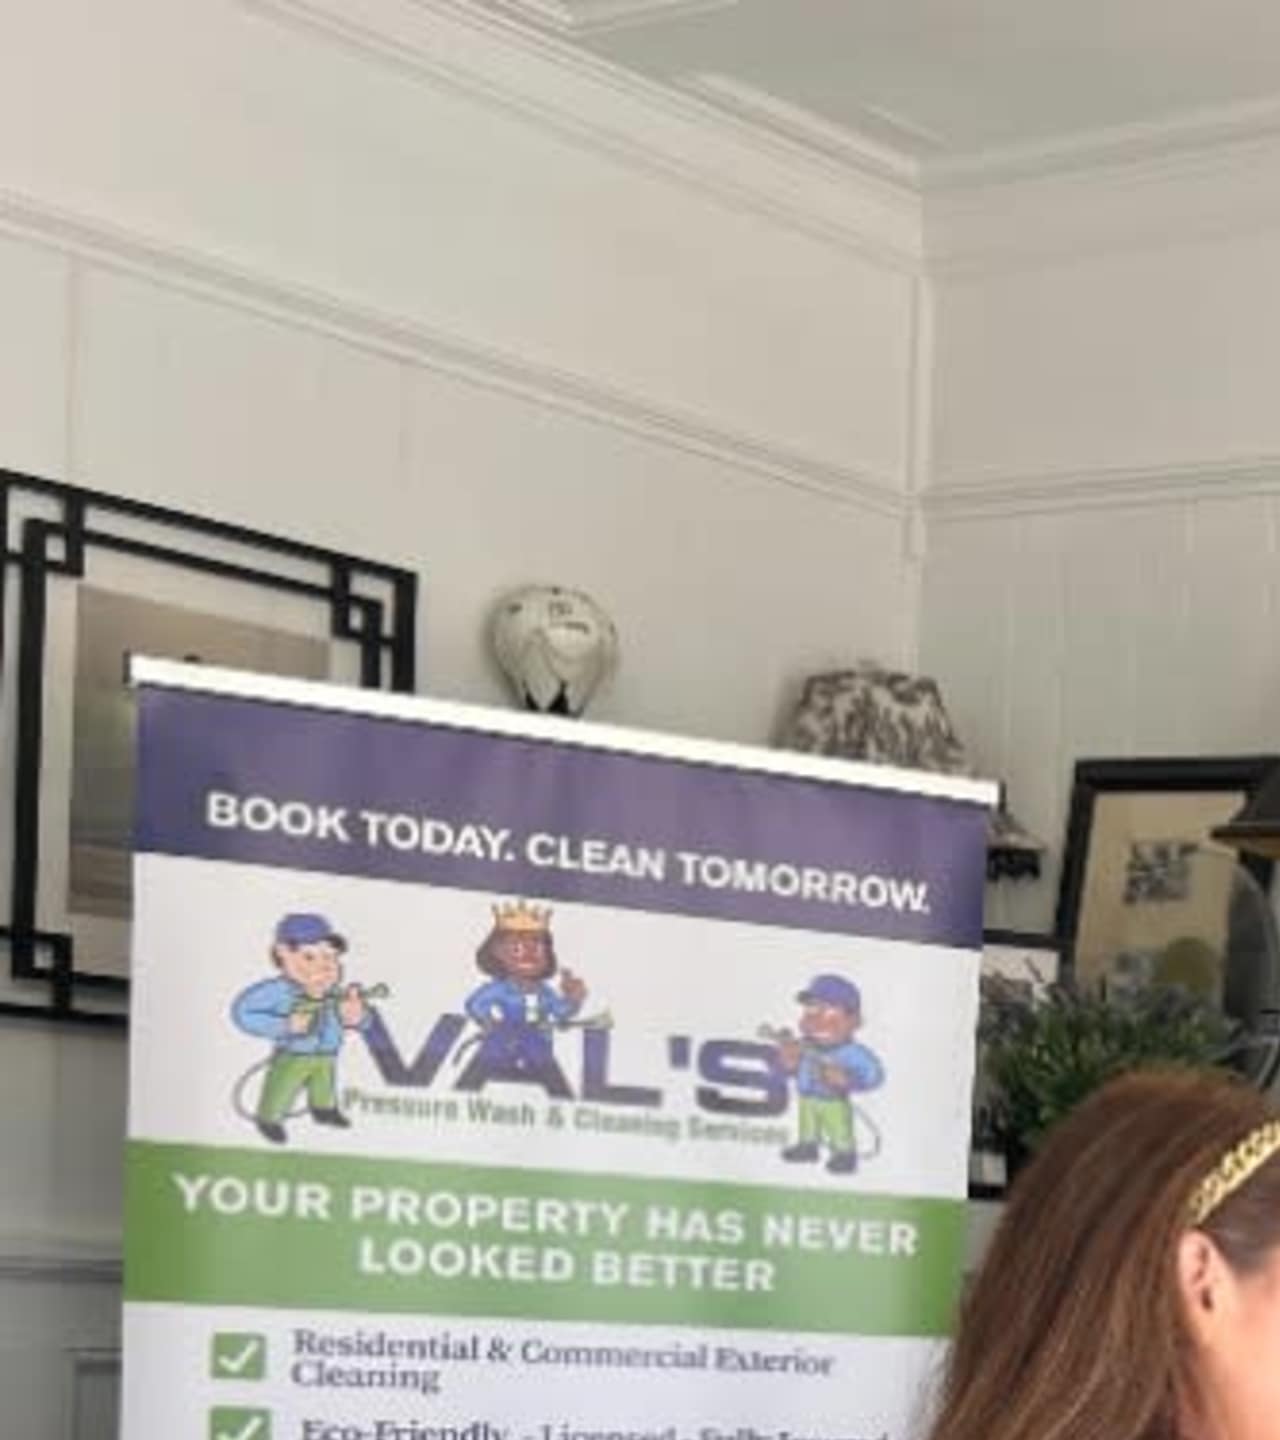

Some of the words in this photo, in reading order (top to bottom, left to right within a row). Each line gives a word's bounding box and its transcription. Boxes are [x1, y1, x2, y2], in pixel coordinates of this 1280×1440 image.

[206, 790, 351, 843] BOOK
[360, 809, 516, 862] TODAY.
[526, 832, 666, 881] CLEAN
[677, 850, 931, 914] TOMORROW.
[364, 1004, 790, 1117] VAL'S
[342, 1089, 459, 1125] Pressure
[468, 1097, 535, 1129] Wash
[545, 1103, 565, 1129] &
[573, 1108, 681, 1143] Cleaning
[688, 1114, 790, 1145] Services
[173, 1172, 333, 1221] YOUR
[350, 1185, 629, 1237] PROPERTY
[646, 1206, 746, 1244] HAS
[762, 1213, 920, 1257] NEVER
[358, 1236, 575, 1281] LOOKED
[592, 1250, 775, 1292] BETTER
[291, 1360, 442, 1396] Cleaning
[293, 1328, 479, 1362] Residential
[486, 1335, 512, 1362] &
[520, 1338, 708, 1371] Commercial
[715, 1347, 835, 1376] Exterior
